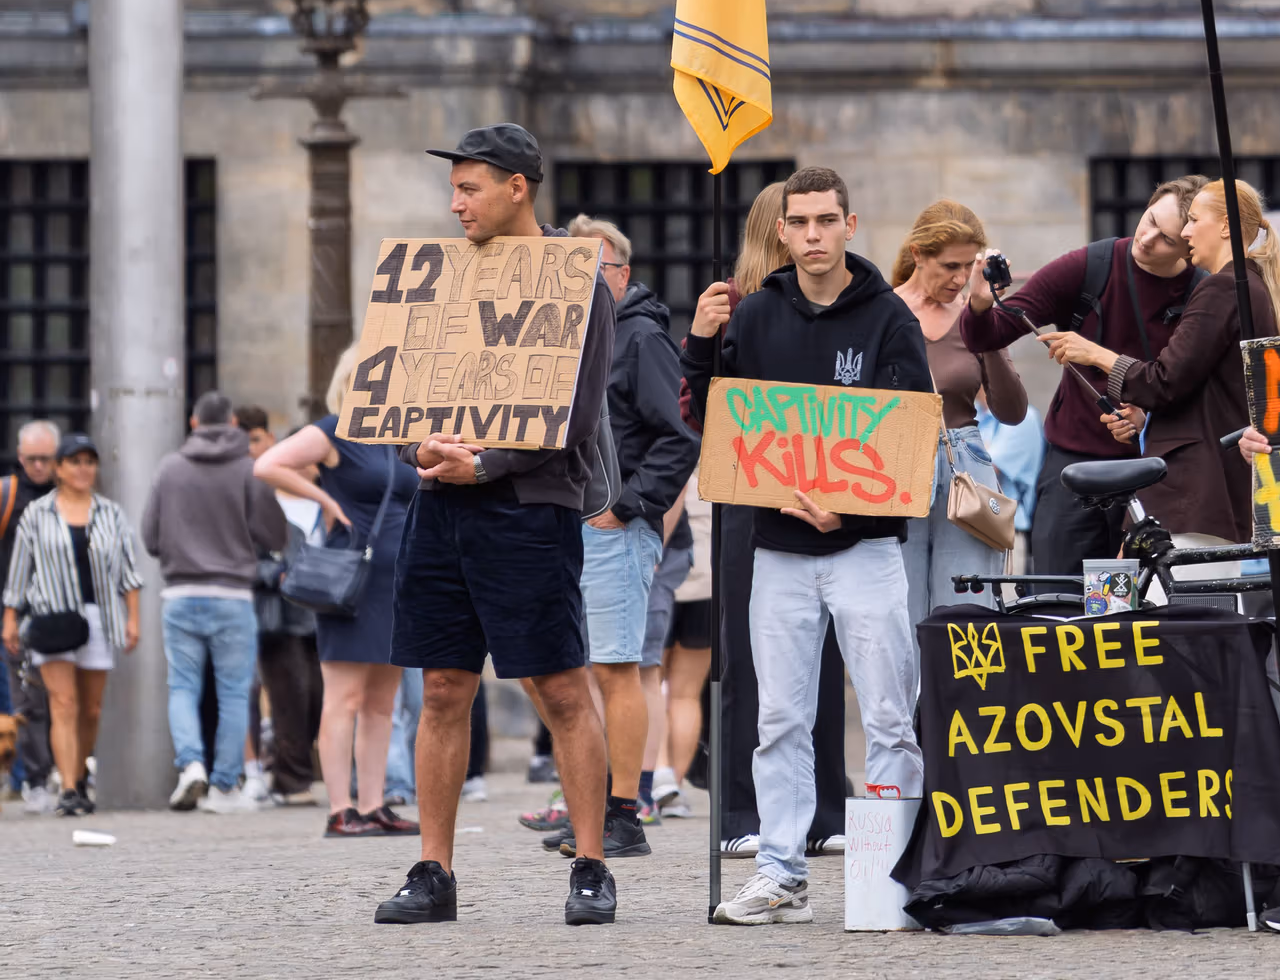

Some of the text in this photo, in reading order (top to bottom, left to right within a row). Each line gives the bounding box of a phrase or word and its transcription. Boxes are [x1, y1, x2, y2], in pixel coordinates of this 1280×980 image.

[370, 242, 595, 304] 12 YEARS
[403, 300, 585, 352] OF WAR
[352, 345, 580, 406] 4 YEARS OF
[347, 403, 571, 448] CAPTIVITY
[1020, 620, 1165, 673] FREE
[948, 691, 1224, 758] AZOVSTAL
